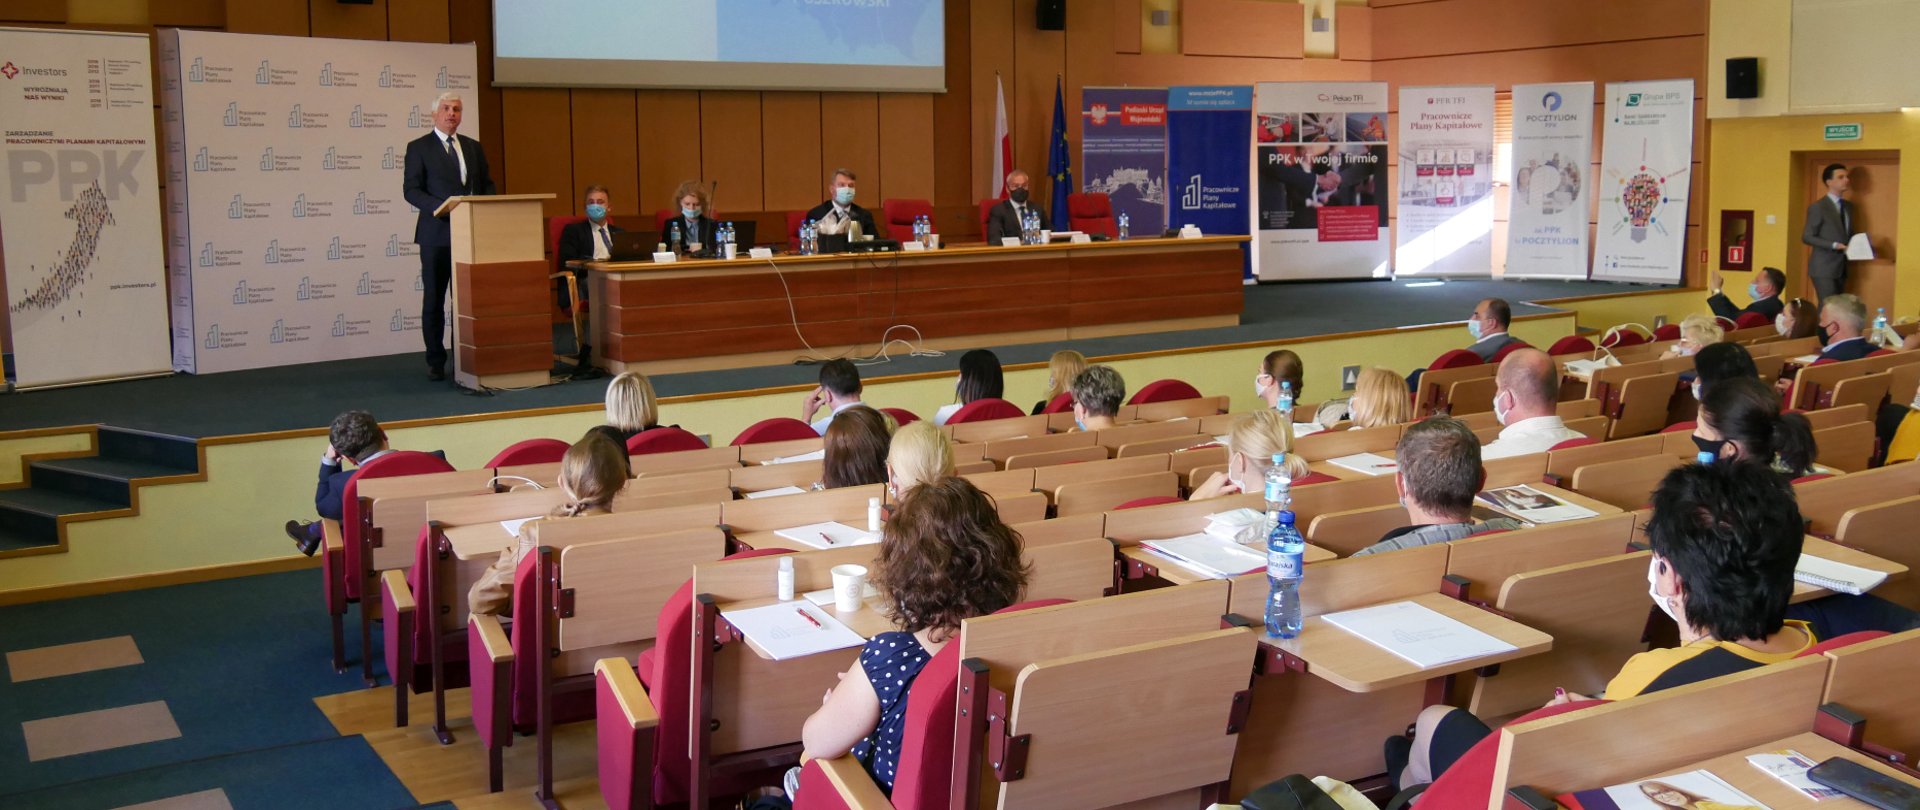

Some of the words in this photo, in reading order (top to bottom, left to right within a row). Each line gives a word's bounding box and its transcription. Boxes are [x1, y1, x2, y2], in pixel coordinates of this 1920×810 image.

[22, 66, 67, 77] Investors
[1410, 122, 1433, 131] Plany
[1435, 121, 1482, 130] Kapitałowe
[1269, 154, 1291, 164] PPK
[1294, 156, 1304, 164] w
[1306, 153, 1341, 166] Twojej
[1345, 152, 1378, 163] firmie
[7, 150, 146, 202] PPK
